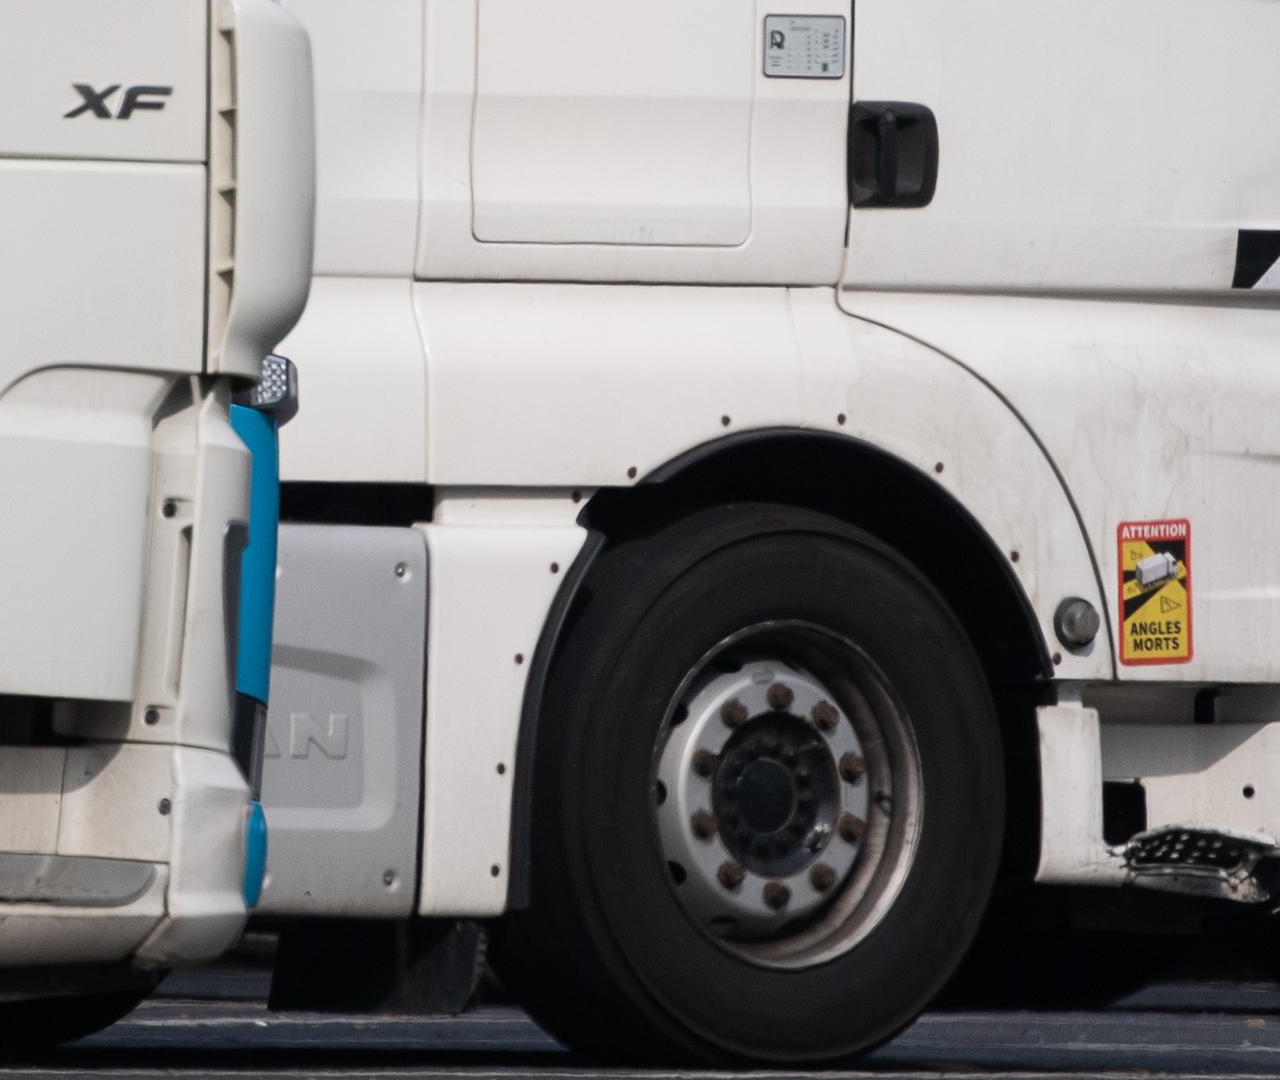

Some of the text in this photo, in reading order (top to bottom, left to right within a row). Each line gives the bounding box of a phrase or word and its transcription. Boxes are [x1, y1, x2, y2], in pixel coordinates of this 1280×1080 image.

[63, 83, 174, 120] XF
[1122, 524, 1186, 539] ATTENTION
[1130, 621, 1182, 636] ANGLES
[1133, 637, 1180, 652] MORTS
